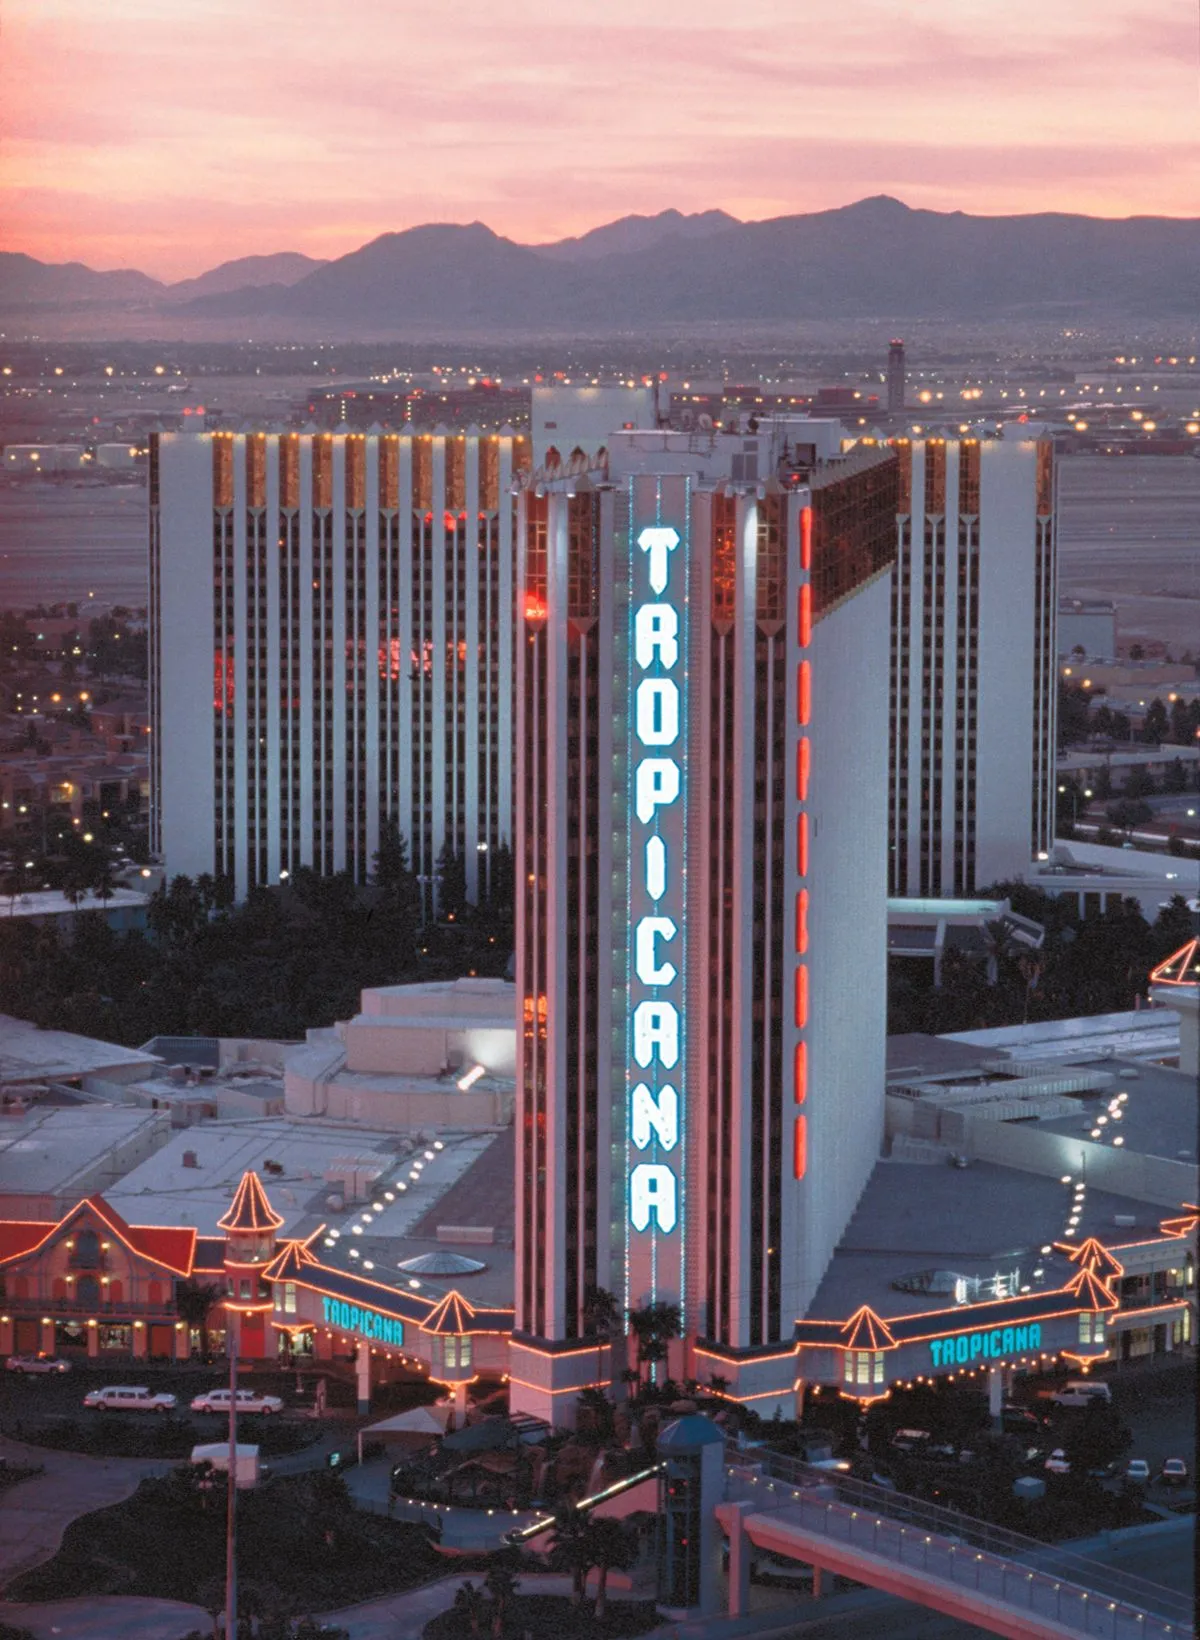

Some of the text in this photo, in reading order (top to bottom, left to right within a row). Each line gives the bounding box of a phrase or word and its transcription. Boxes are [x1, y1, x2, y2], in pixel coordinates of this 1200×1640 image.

[630, 527, 681, 1234] TROPICANA
[322, 1296, 404, 1347] TROPICANA
[929, 1323, 1041, 1367] TROPICANA
